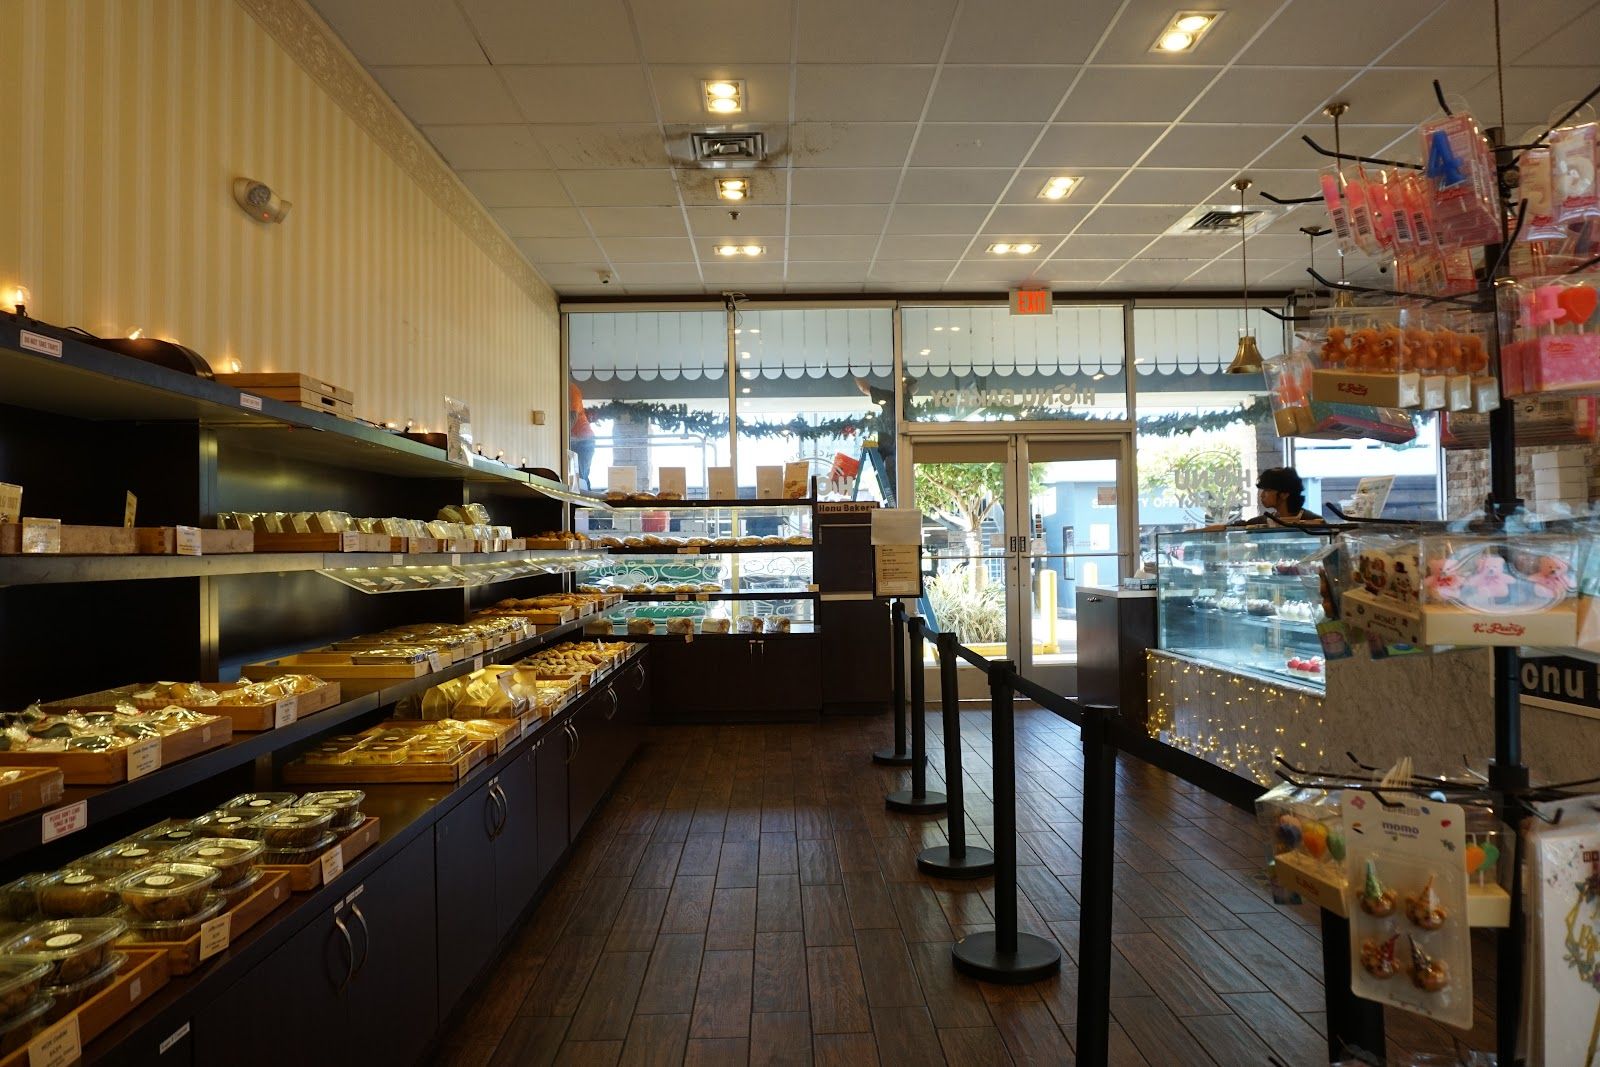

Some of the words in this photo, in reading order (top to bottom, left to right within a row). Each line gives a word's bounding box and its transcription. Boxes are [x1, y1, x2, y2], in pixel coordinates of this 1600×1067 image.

[1017, 291, 1046, 313] EXIT
[819, 504, 842, 512] Honu
[1521, 662, 1585, 699] onu
[1382, 822, 1420, 835] momo
